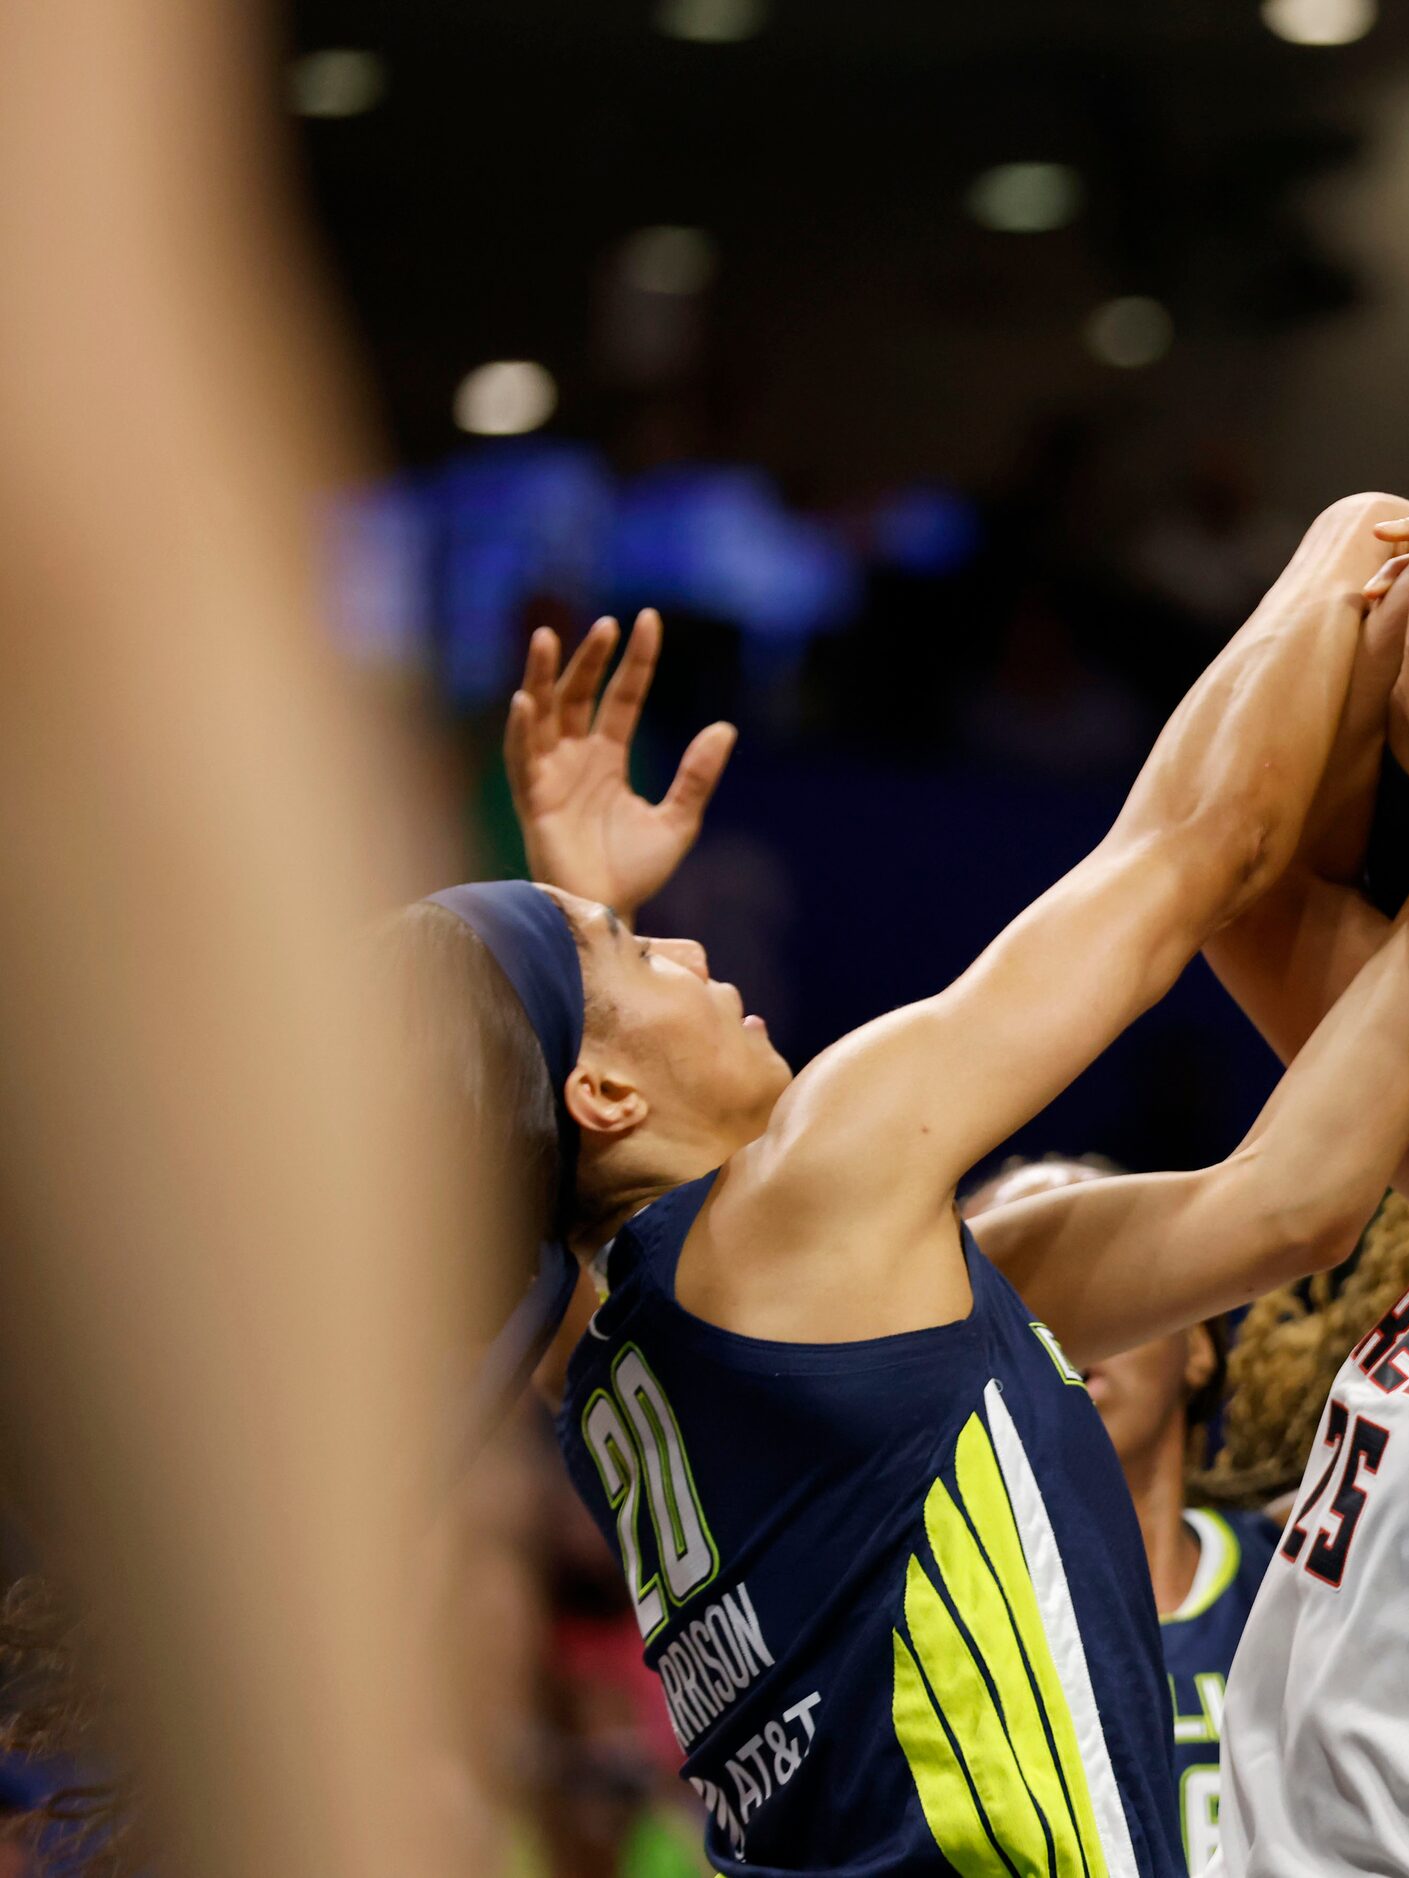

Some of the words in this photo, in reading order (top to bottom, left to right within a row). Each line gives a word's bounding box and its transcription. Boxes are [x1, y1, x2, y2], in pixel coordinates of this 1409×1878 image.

[581, 1340, 720, 1647] 20
[1280, 1398, 1390, 1589] 25
[658, 1581, 776, 1755] RRISON
[725, 1690, 822, 1825] AT&T
